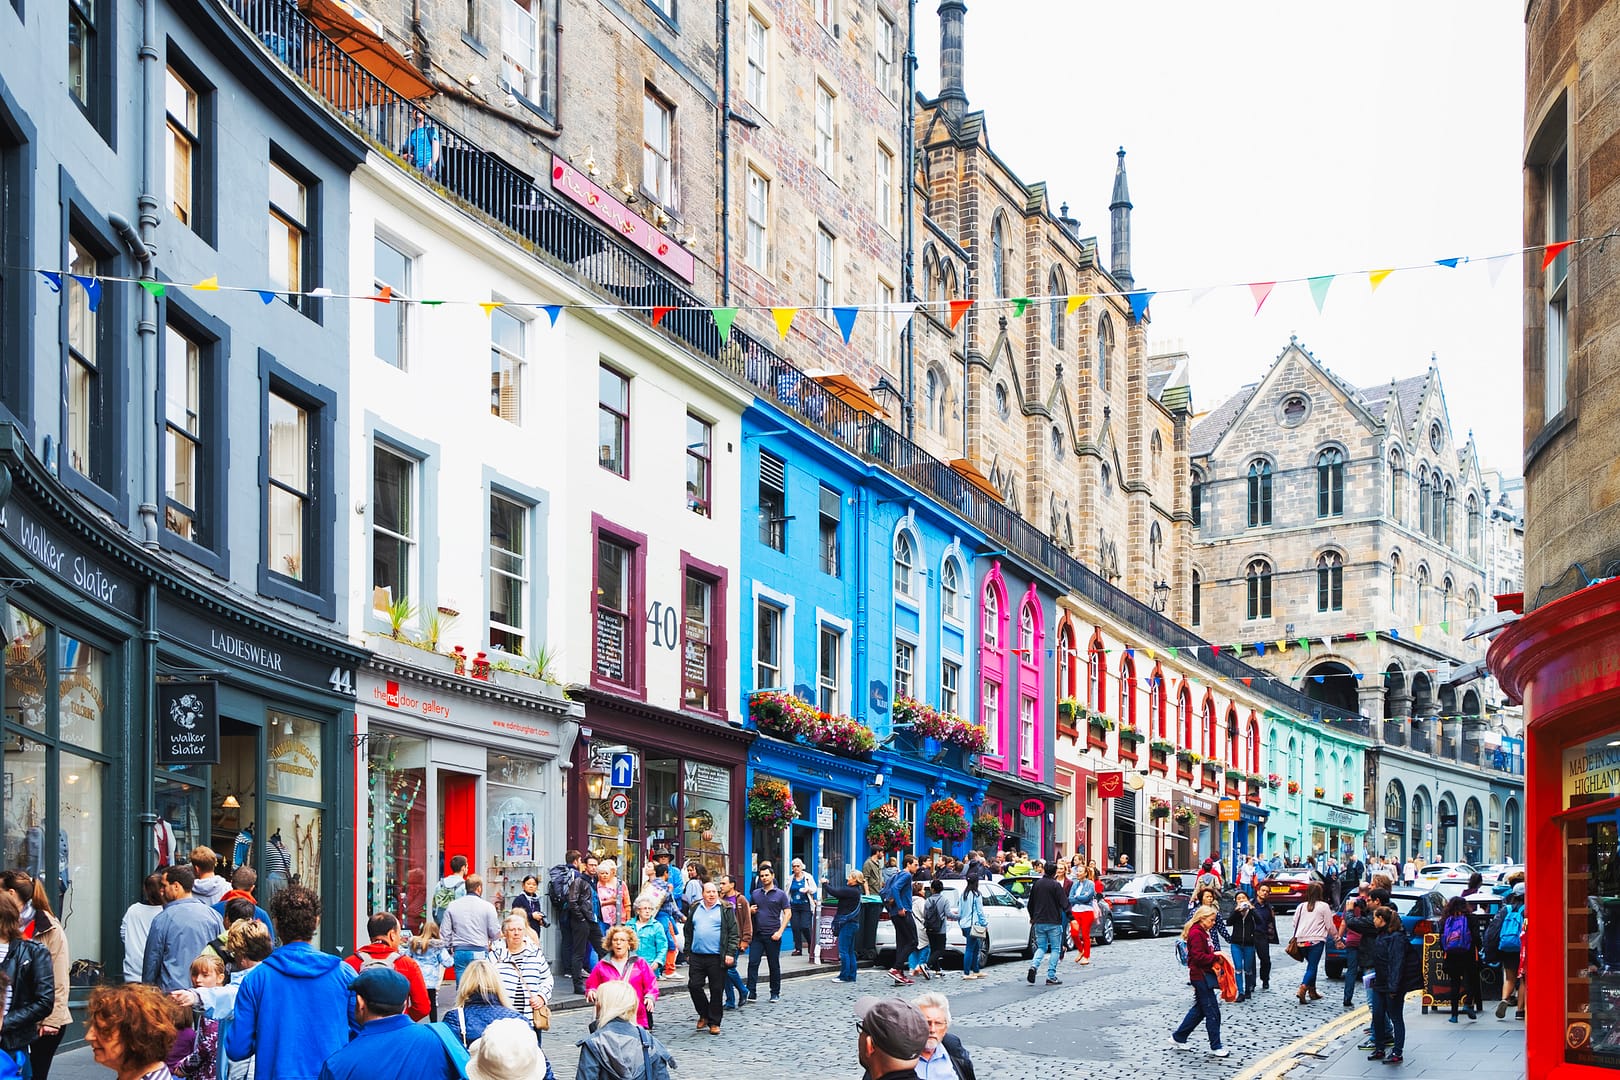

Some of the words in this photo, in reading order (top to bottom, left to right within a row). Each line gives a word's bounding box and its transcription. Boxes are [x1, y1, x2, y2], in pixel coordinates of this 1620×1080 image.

[20, 515, 65, 573] Walker
[73, 555, 118, 604] Slater
[646, 600, 677, 651] 40
[211, 629, 282, 672] LADIESWEAR
[373, 686, 386, 701] the
[387, 691, 399, 704] red
[400, 692, 419, 708] door
[422, 699, 450, 718] gallery
[1569, 753, 1594, 777] MADE
[1595, 749, 1605, 770] IN
[613, 800, 627, 810] 20
